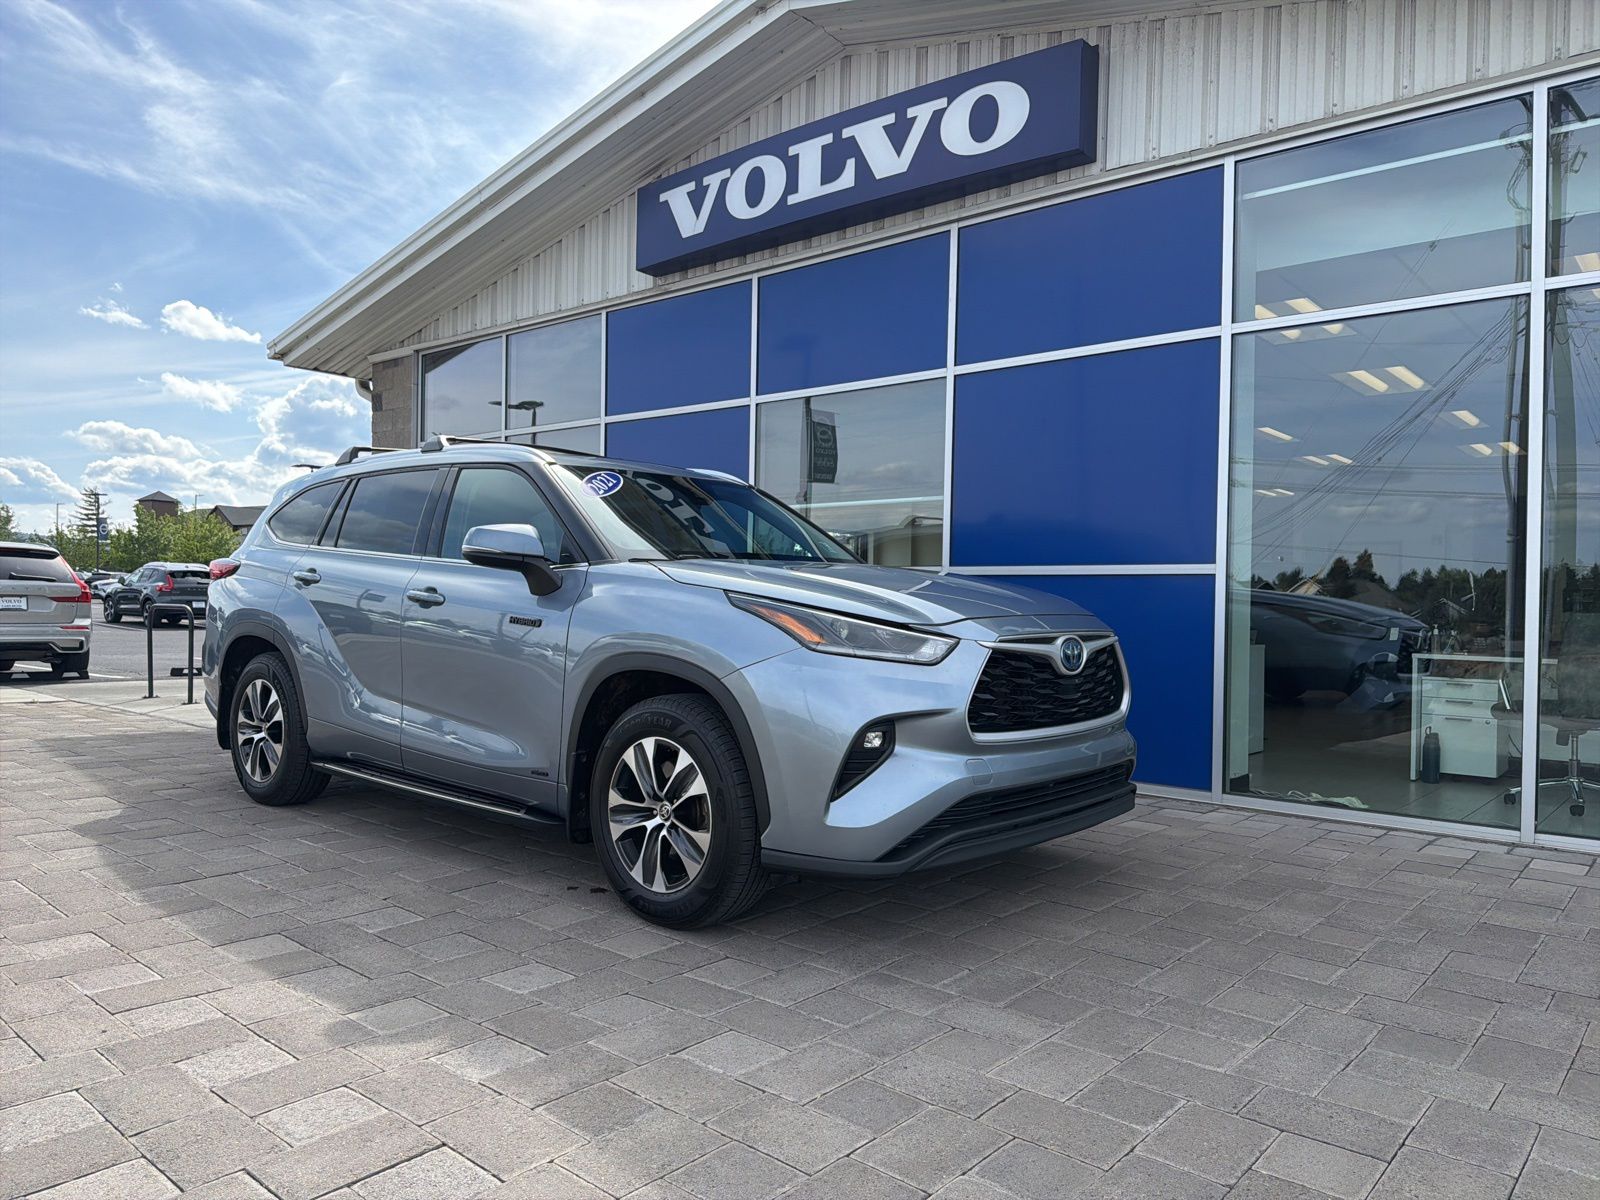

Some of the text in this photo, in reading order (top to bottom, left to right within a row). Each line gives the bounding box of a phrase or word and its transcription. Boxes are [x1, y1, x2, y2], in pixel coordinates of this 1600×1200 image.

[659, 80, 1031, 239] VOLVO
[587, 473, 617, 495] 2021
[510, 616, 535, 627] HYBRID
